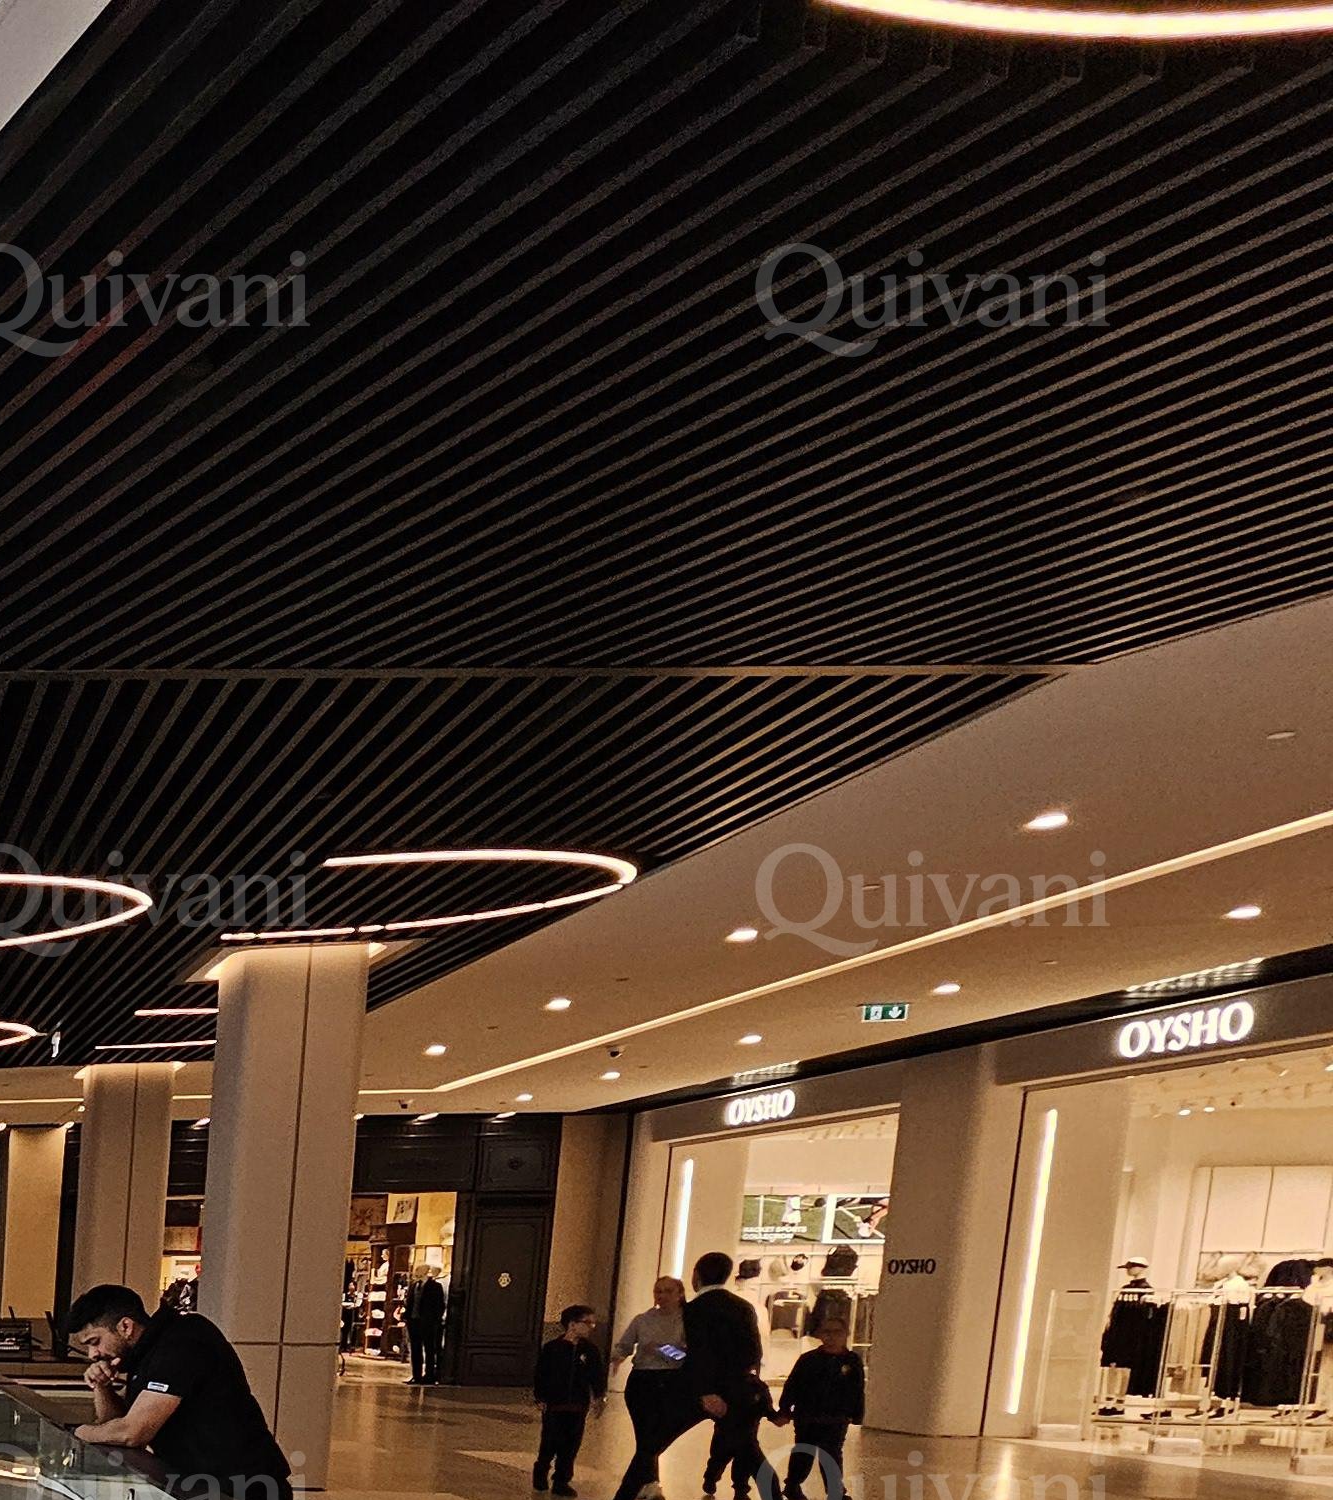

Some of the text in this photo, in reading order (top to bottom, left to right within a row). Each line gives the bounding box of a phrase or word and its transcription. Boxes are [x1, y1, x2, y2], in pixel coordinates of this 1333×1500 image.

[1117, 1001, 1256, 1059] OYSHO
[724, 1088, 797, 1127] OYSHO
[887, 1258, 937, 1275] OYSHO
